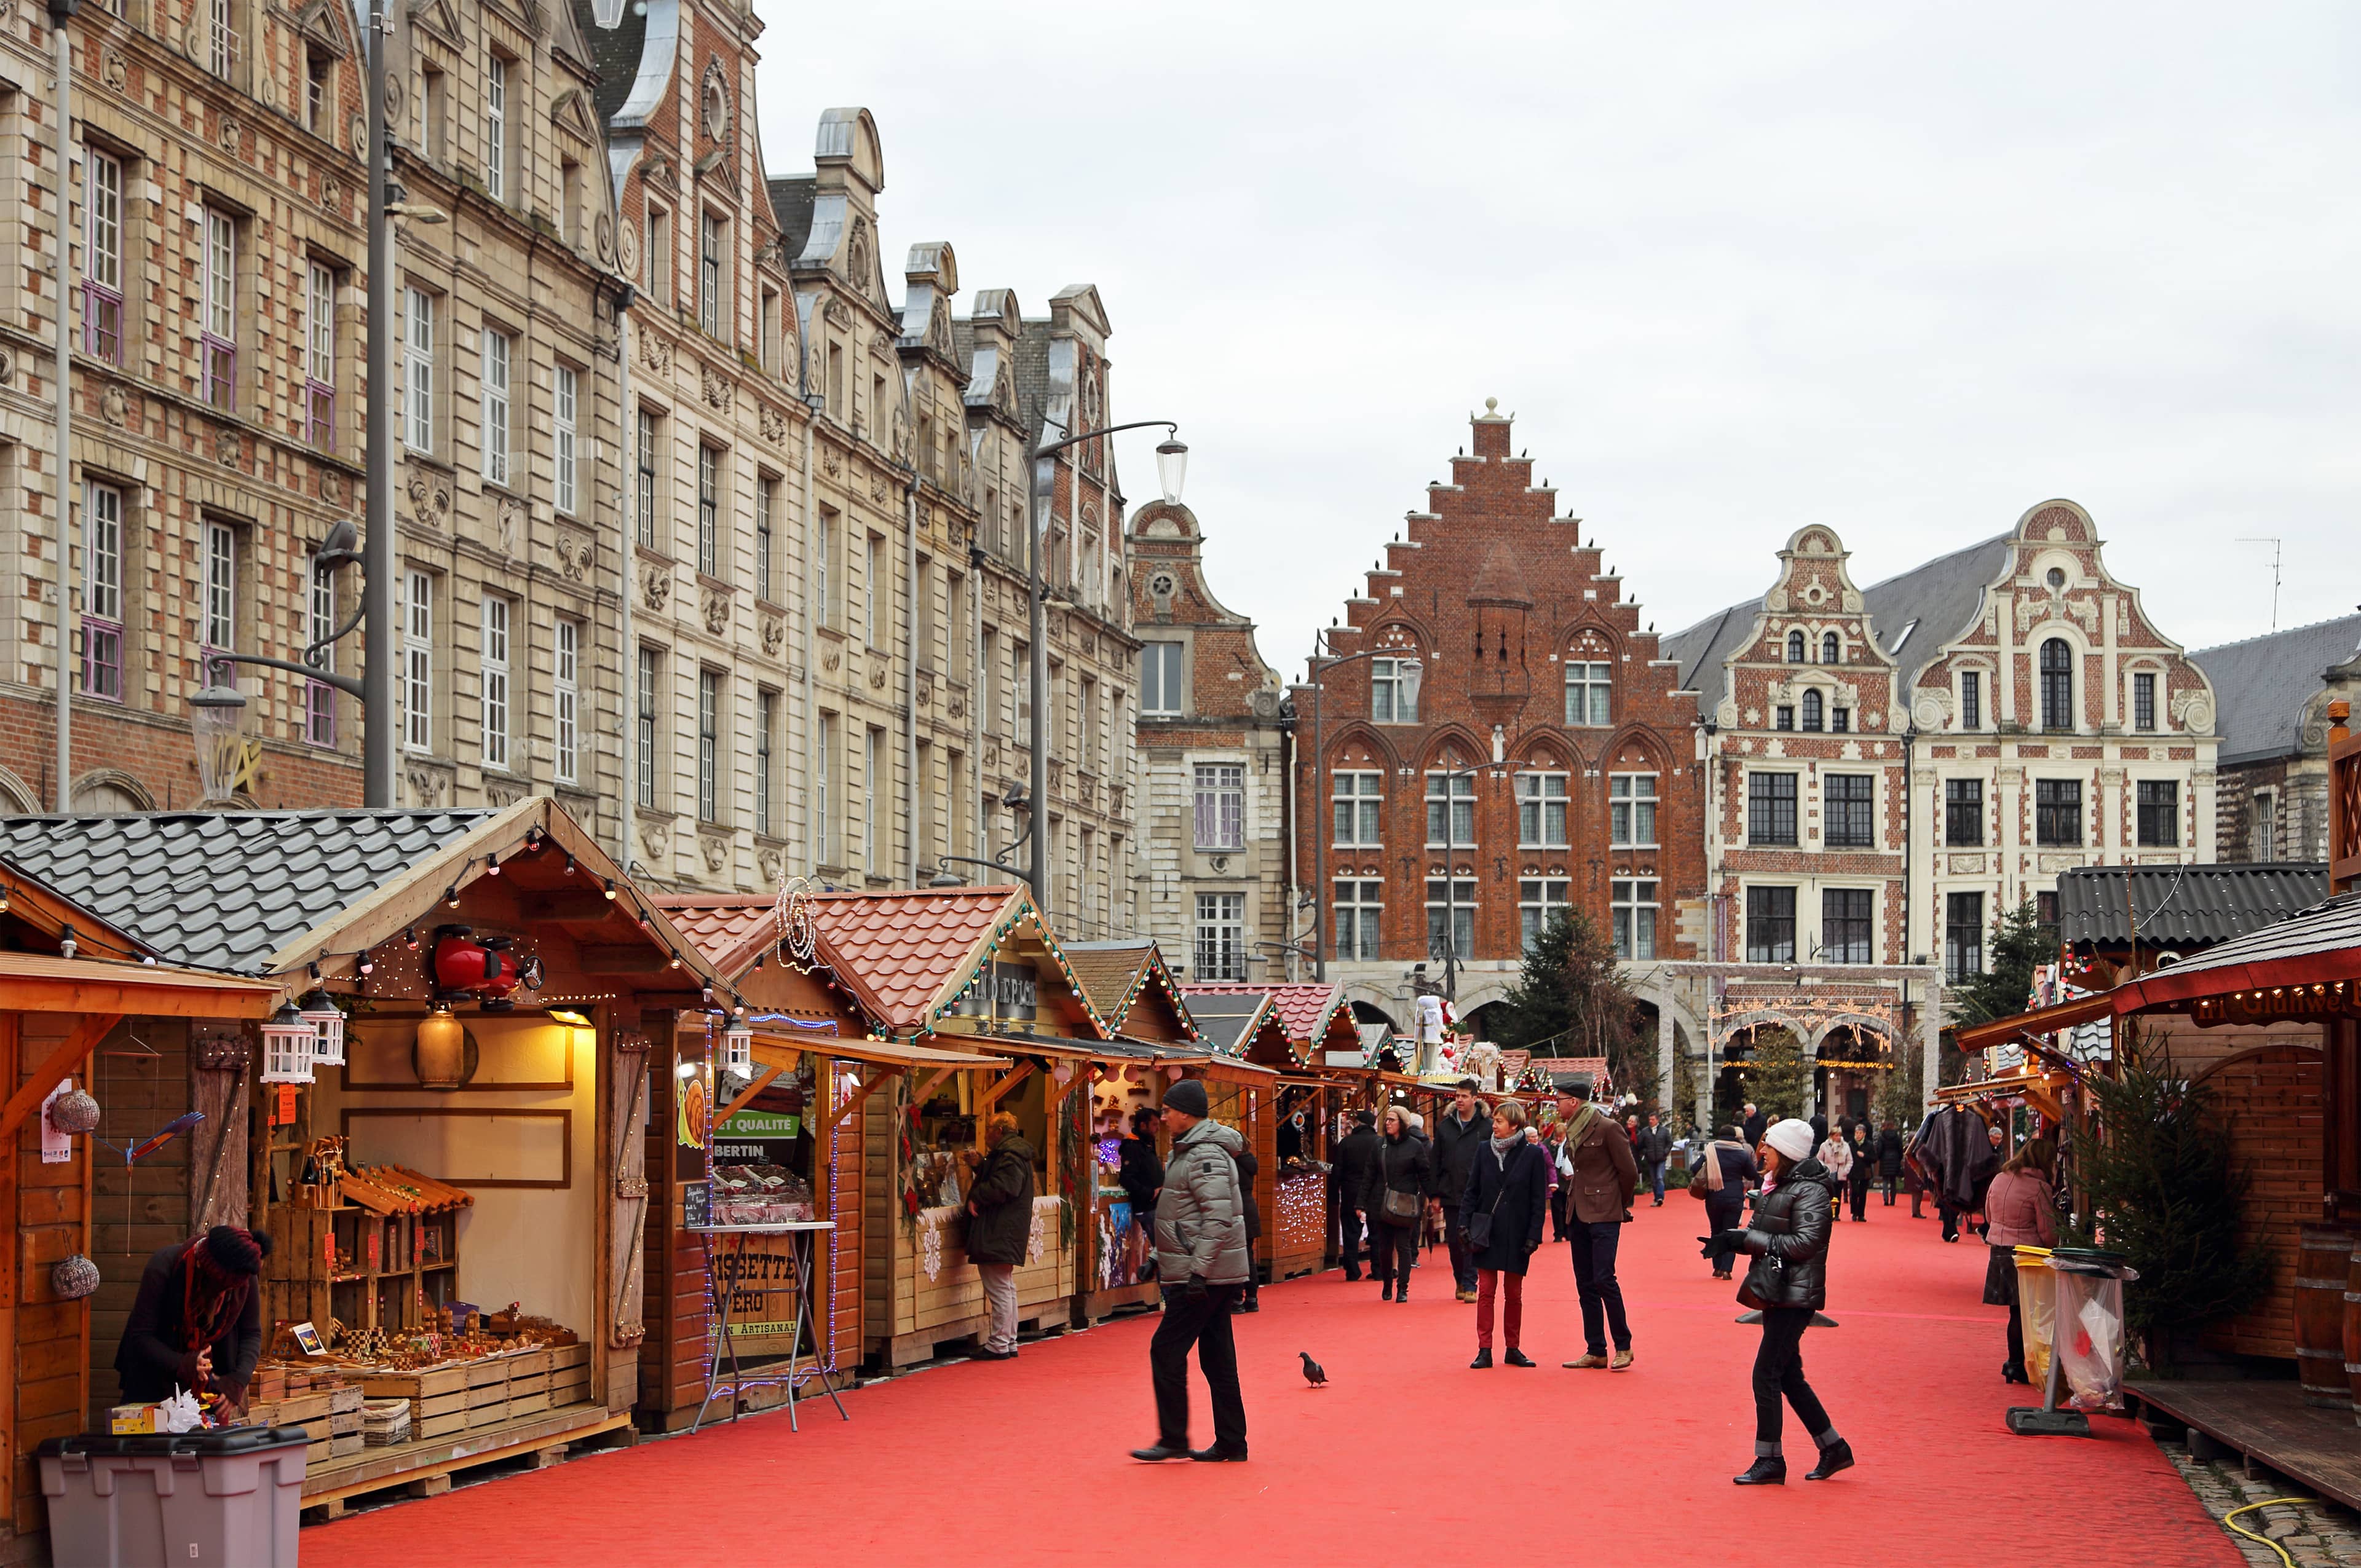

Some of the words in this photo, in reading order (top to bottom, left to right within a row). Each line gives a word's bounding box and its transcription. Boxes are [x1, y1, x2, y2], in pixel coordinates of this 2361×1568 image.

[737, 1117, 791, 1132] QUALITÉ
[714, 1145, 764, 1157] BERTIN
[712, 1253, 797, 1281] ISSETTE
[741, 1323, 796, 1334] ARTISANAL
